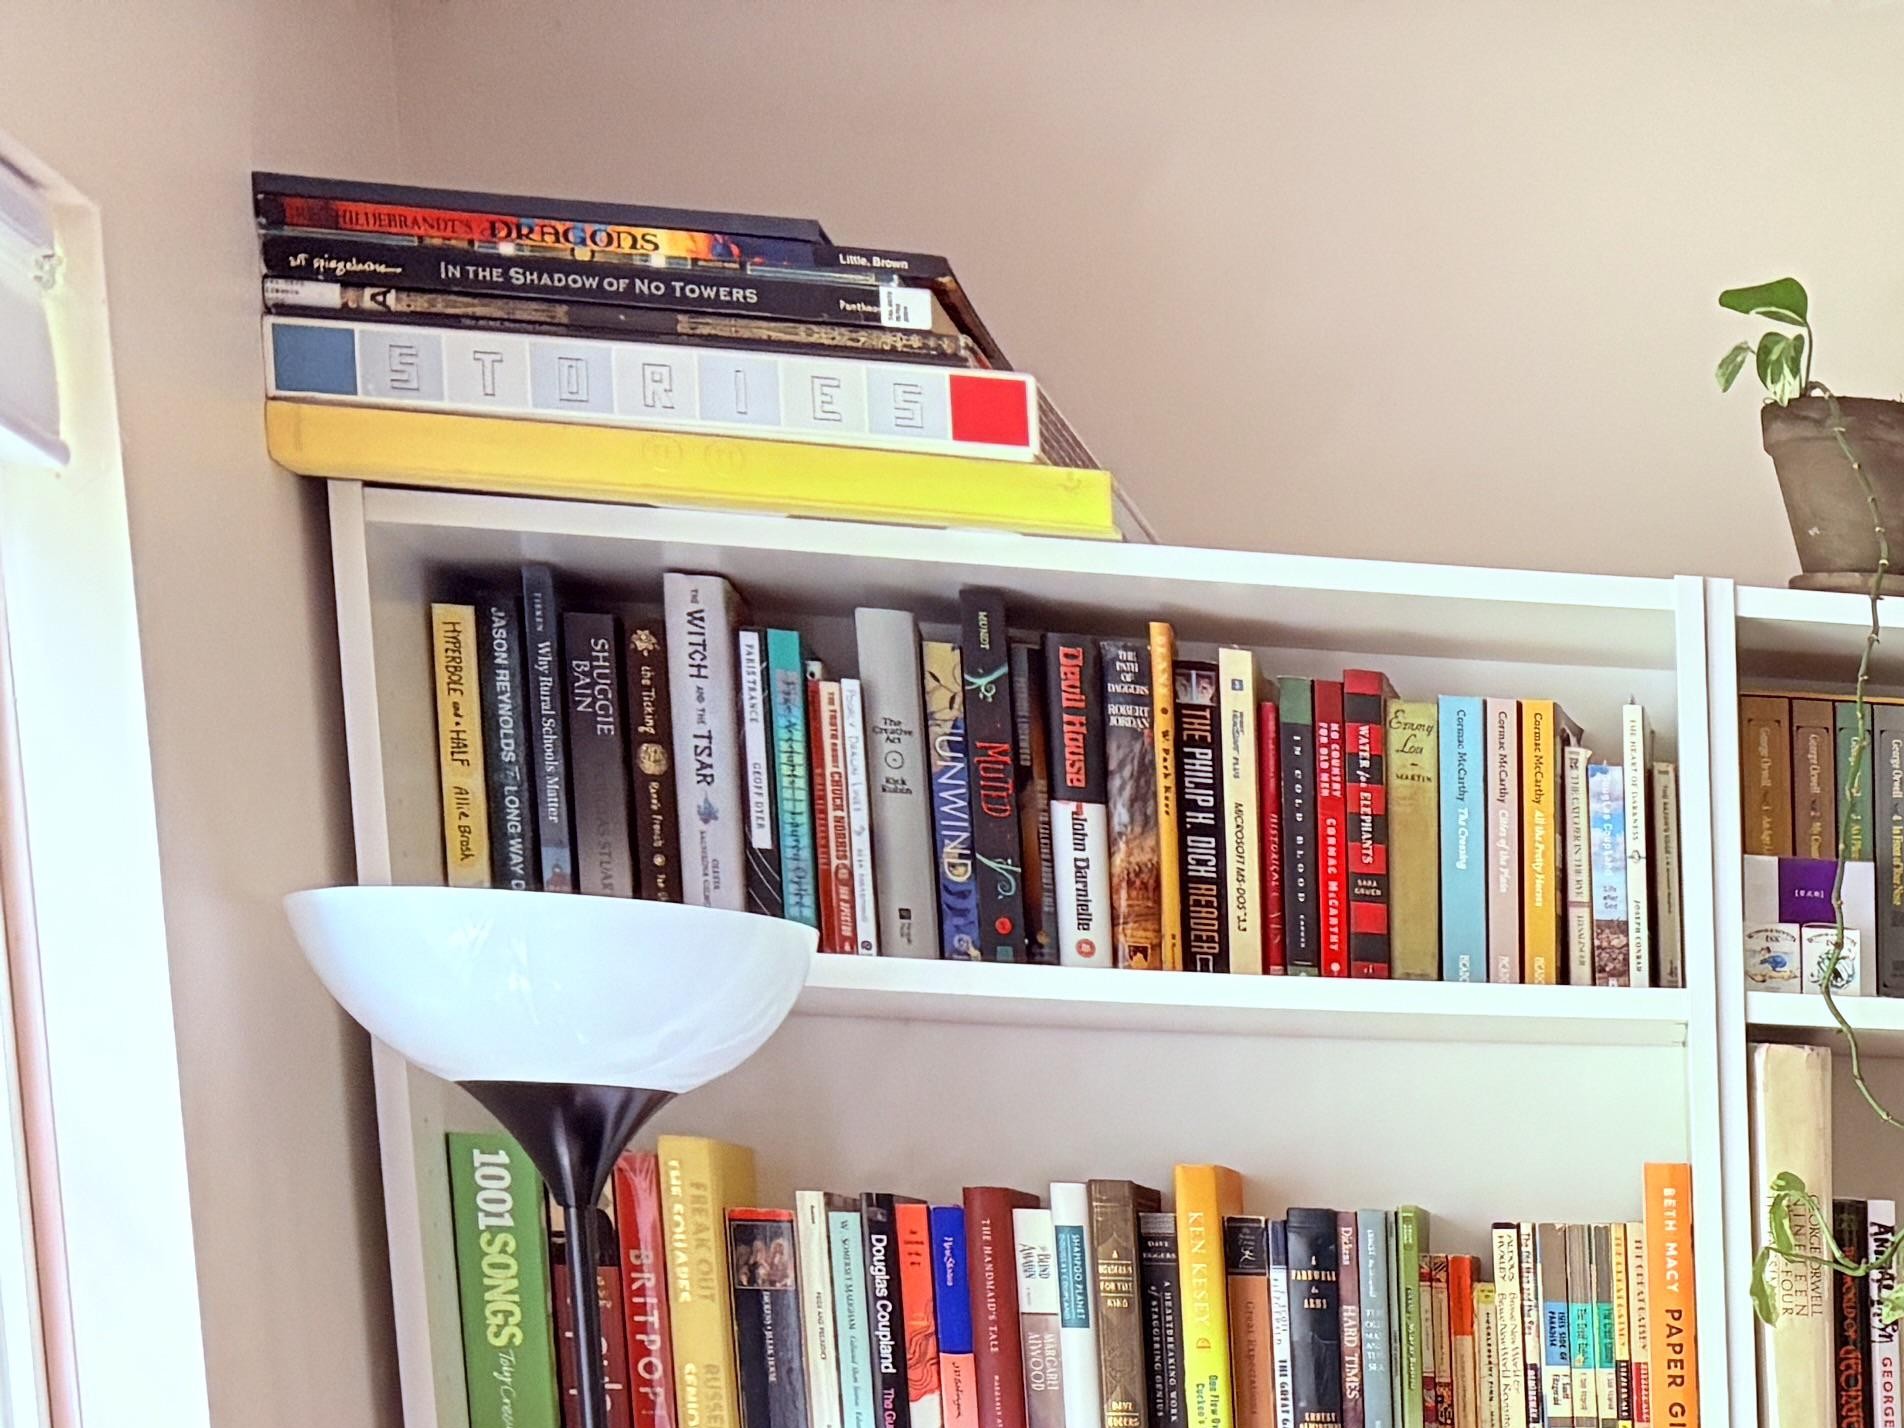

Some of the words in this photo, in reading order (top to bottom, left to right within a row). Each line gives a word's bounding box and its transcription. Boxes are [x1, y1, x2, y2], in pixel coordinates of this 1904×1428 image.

[488, 219, 661, 253] DRAGONS
[440, 261, 459, 280] IN
[464, 264, 504, 285] THE
[510, 268, 597, 292] SHADOW
[603, 279, 628, 294] OF
[634, 279, 667, 300] NO
[673, 282, 759, 306] TOWERS
[491, 608, 508, 663] JASON
[686, 609, 708, 680] WITCH
[572, 660, 592, 712] BAIN
[591, 638, 614, 736] SHUGGIE
[495, 670, 516, 762] REYNOLDS
[1182, 709, 1212, 741] THE
[451, 729, 469, 767] HALF
[692, 729, 714, 787] TSAR
[1357, 725, 1371, 767] WATER
[1183, 745, 1214, 807] PHILIP
[504, 786, 522, 838] LONG
[509, 838, 524, 874] WAY
[1325, 818, 1337, 871] CORMAC
[1073, 857, 1092, 931] Darnielle
[1188, 883, 1220, 954] READER
[473, 1149, 514, 1230] 1001
[1663, 1188, 1677, 1232] BETH
[1188, 1211, 1204, 1255] KEN
[479, 1232, 523, 1347] SONGS
[871, 1234, 891, 1295] Douglas
[1192, 1261, 1210, 1326] KESEY
[1664, 1242, 1680, 1294] MACY
[875, 1300, 896, 1373] Coupland
[1665, 1308, 1683, 1388] PAPER
[1881, 1356, 1896, 1422] GEORGE
